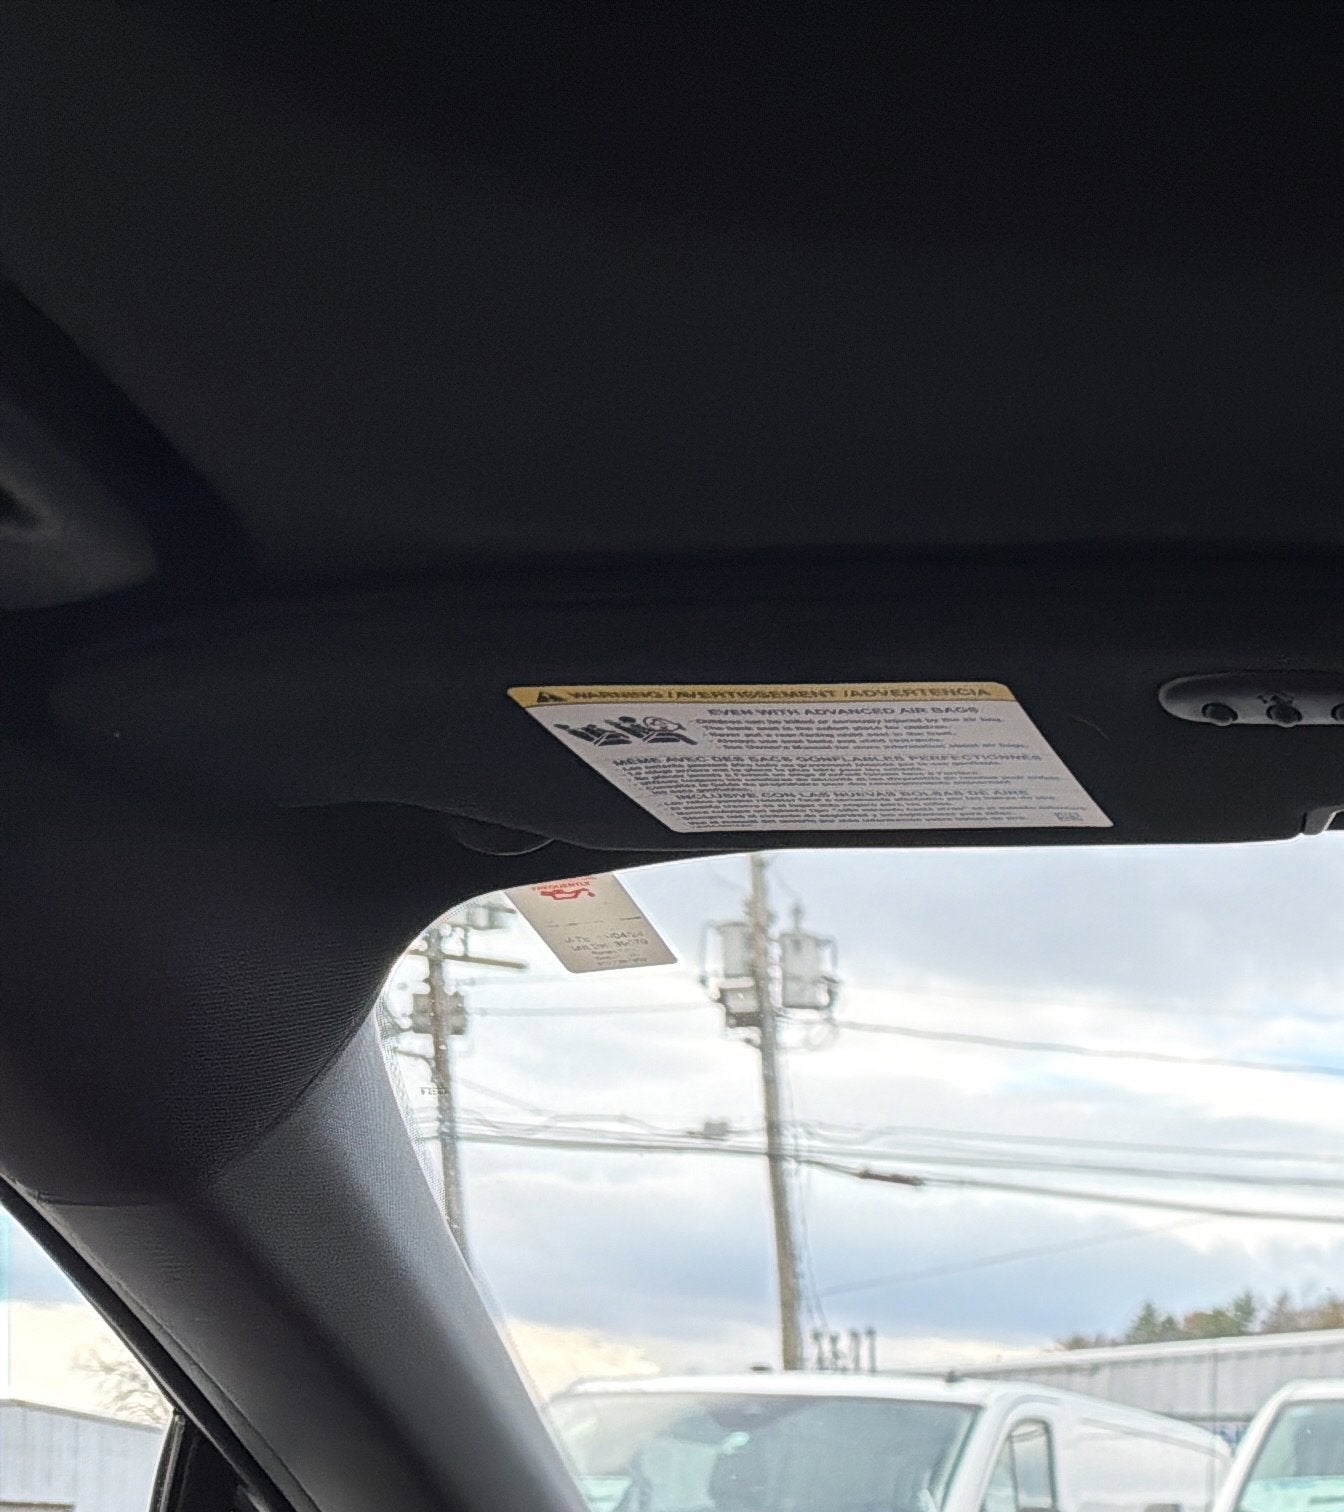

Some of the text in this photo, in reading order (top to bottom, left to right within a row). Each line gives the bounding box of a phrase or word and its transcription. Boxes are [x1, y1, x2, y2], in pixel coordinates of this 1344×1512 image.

[707, 706, 980, 717] EVEN WITH ADVANCED AIR BAGS
